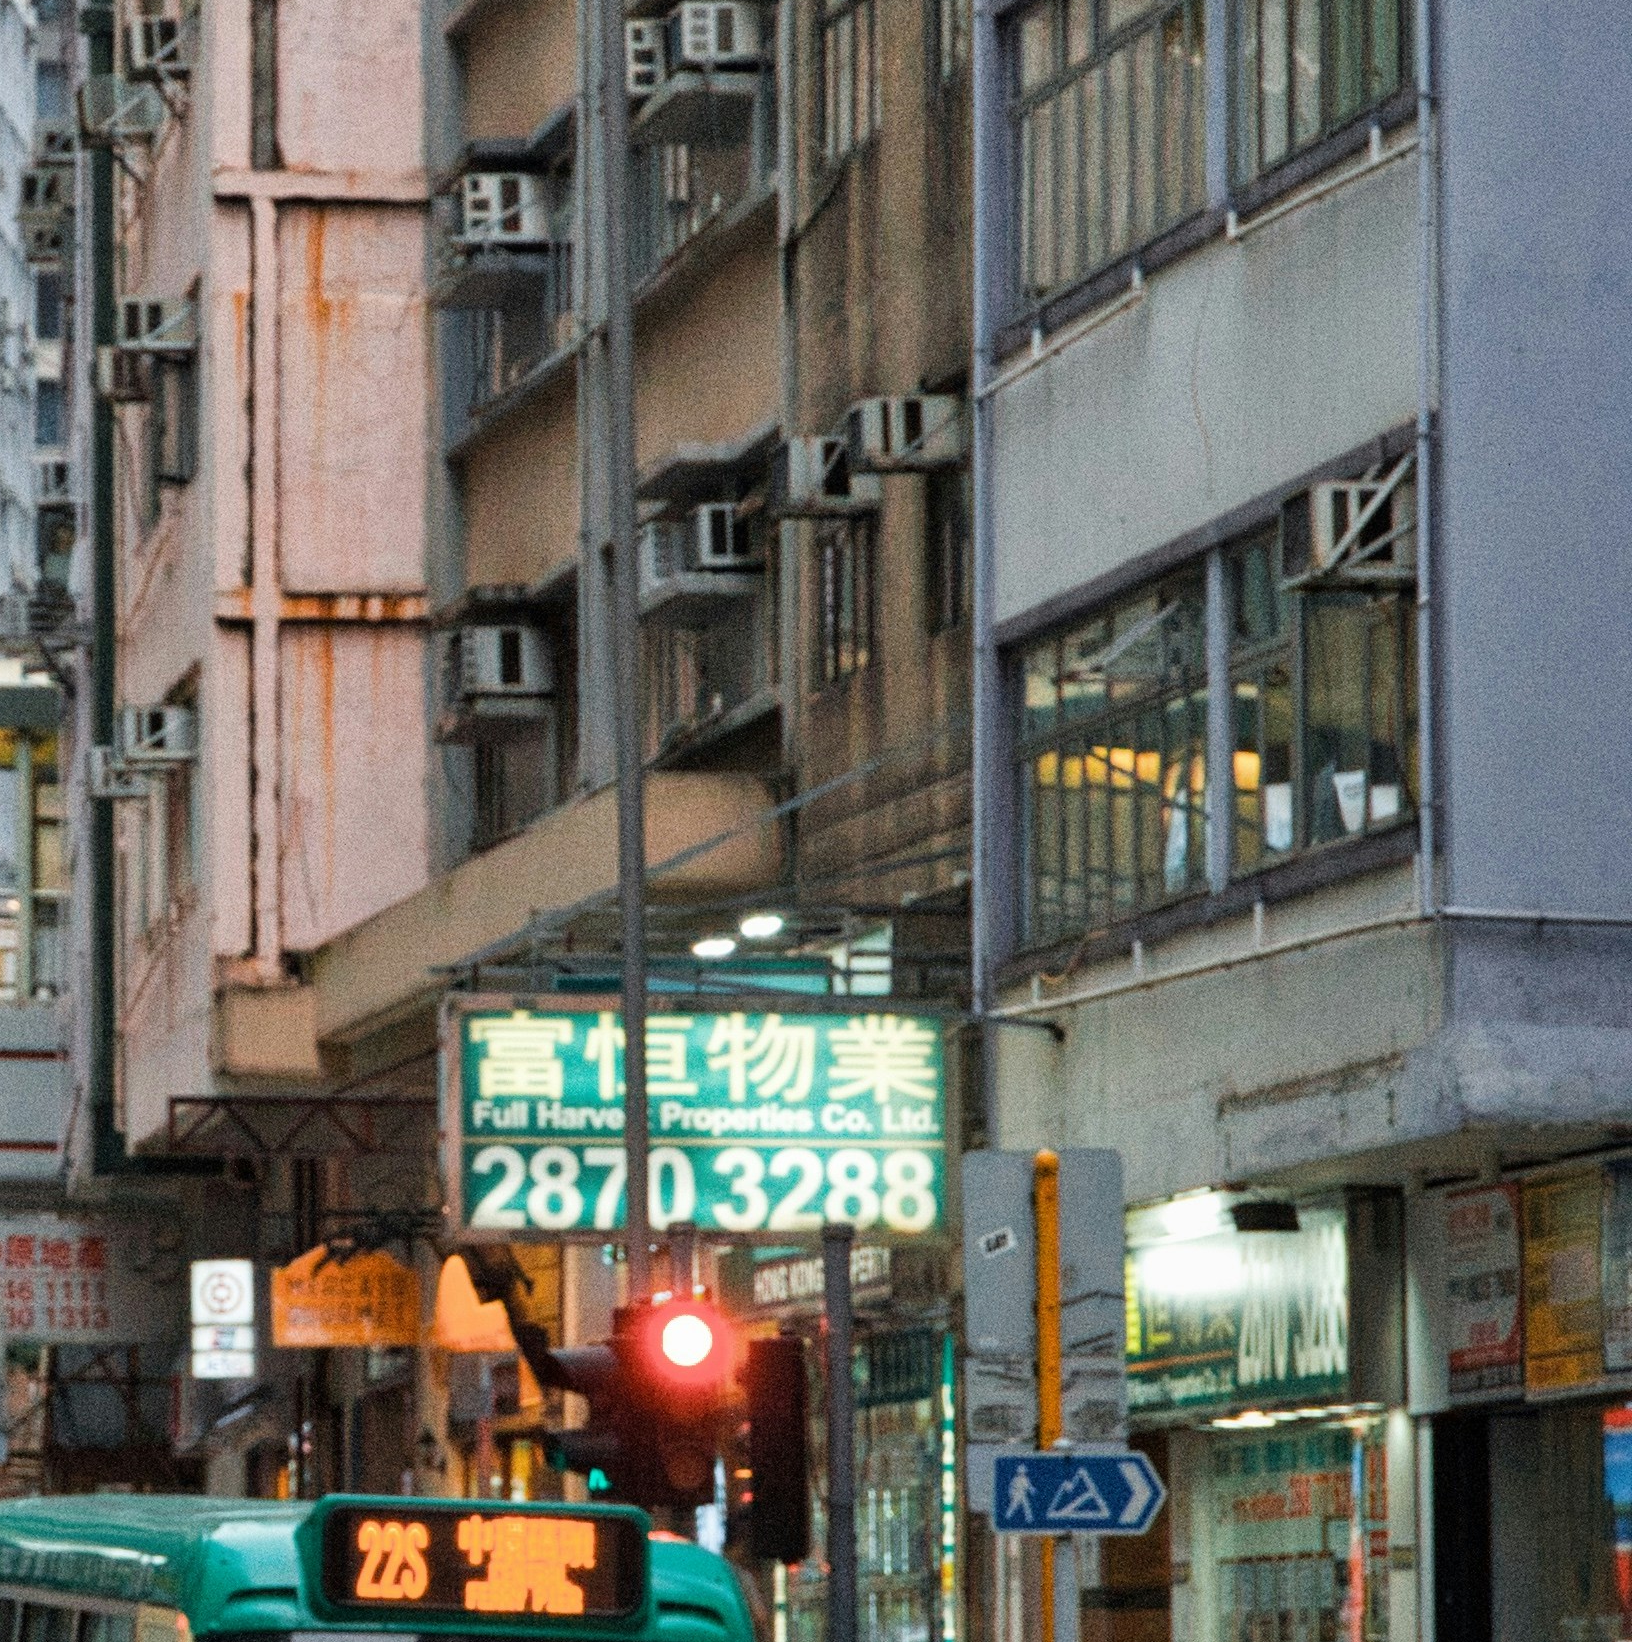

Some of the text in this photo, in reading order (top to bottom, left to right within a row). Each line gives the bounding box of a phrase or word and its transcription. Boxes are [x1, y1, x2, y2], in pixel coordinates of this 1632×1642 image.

[473, 1100, 941, 1137] Full Harve Properties Co. Ltd.
[470, 1146, 938, 1233] 2870 3288
[356, 1520, 429, 1599] 22S
